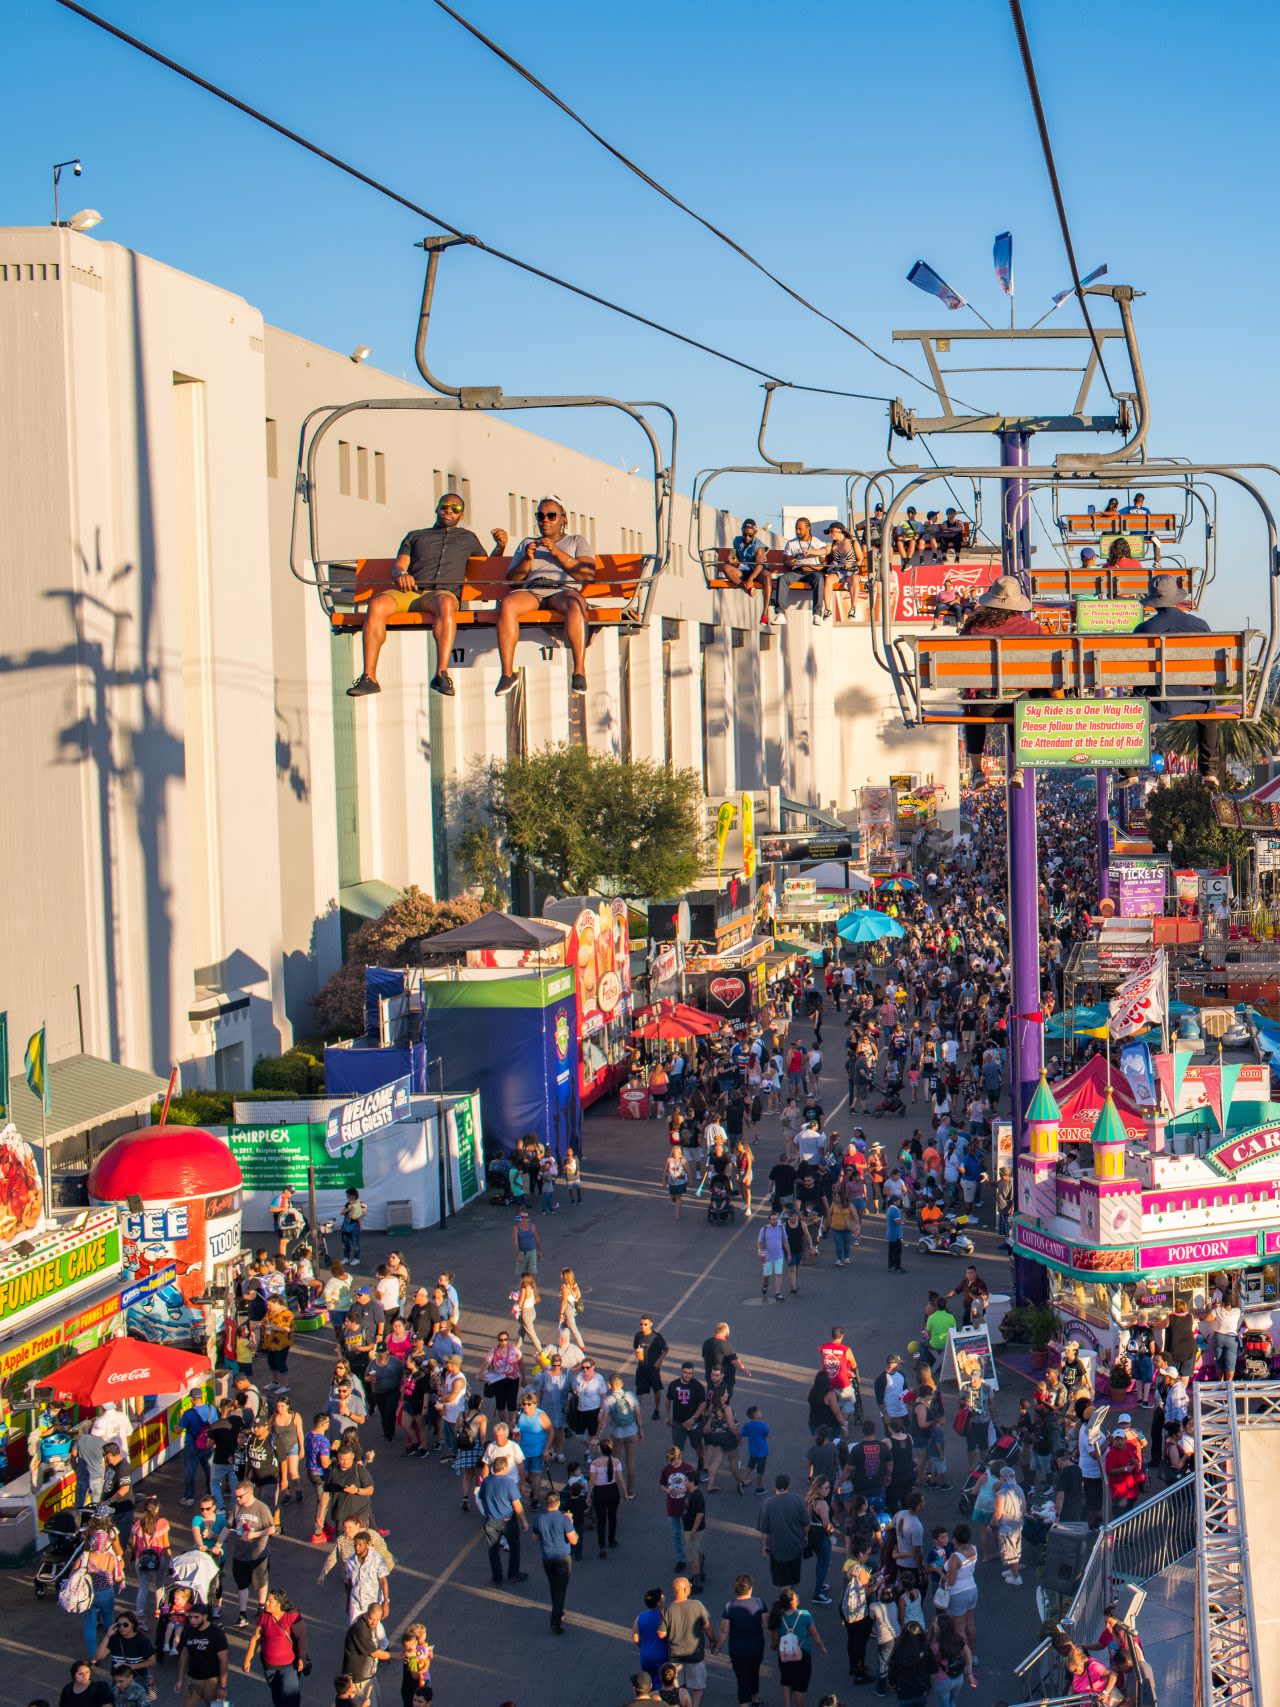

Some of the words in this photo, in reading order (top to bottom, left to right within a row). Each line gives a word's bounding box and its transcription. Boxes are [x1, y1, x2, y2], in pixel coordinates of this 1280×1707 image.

[1026, 705, 1041, 717] Sky
[1044, 705, 1063, 716] Ride
[1066, 705, 1074, 716] is
[1084, 705, 1100, 716] One
[1102, 704, 1120, 717] Way
[1124, 704, 1143, 715] Ride
[1022, 721, 1047, 731] Please
[1048, 721, 1073, 733] follow
[1074, 721, 1088, 731] the
[1089, 720, 1134, 731] Instructions
[1136, 720, 1144, 732] of
[1020, 738, 1032, 748] the
[1034, 737, 1073, 748] Attendant
[1075, 738, 1084, 748] at
[1085, 737, 1098, 748] the
[1100, 736, 1114, 747] End
[1116, 736, 1124, 750] of
[1126, 736, 1144, 747] Ride
[1122, 868, 1164, 880] TICKETS
[1212, 880, 1222, 892] C
[343, 1085, 395, 1124] WELCOME
[341, 1121, 362, 1142] FAIR
[362, 1106, 393, 1134] GUESTS
[231, 1128, 290, 1143] FAIRPLEX
[1058, 1128, 1090, 1140] KING
[278, 1146, 300, 1154] achieved
[1022, 1230, 1046, 1250] COTTON
[1045, 1238, 1065, 1259] CANDY
[1168, 1241, 1229, 1262] POPCORN
[0, 1261, 63, 1316] FUNNEL
[67, 1234, 107, 1280] CAKE
[122, 1287, 140, 1304] OREO
[80, 1307, 103, 1328] FUNNEL
[103, 1297, 119, 1316] CAKE
[3, 1346, 30, 1372] Apple
[31, 1334, 54, 1356] Fries
[108, 1367, 151, 1384] Coca-Cola
